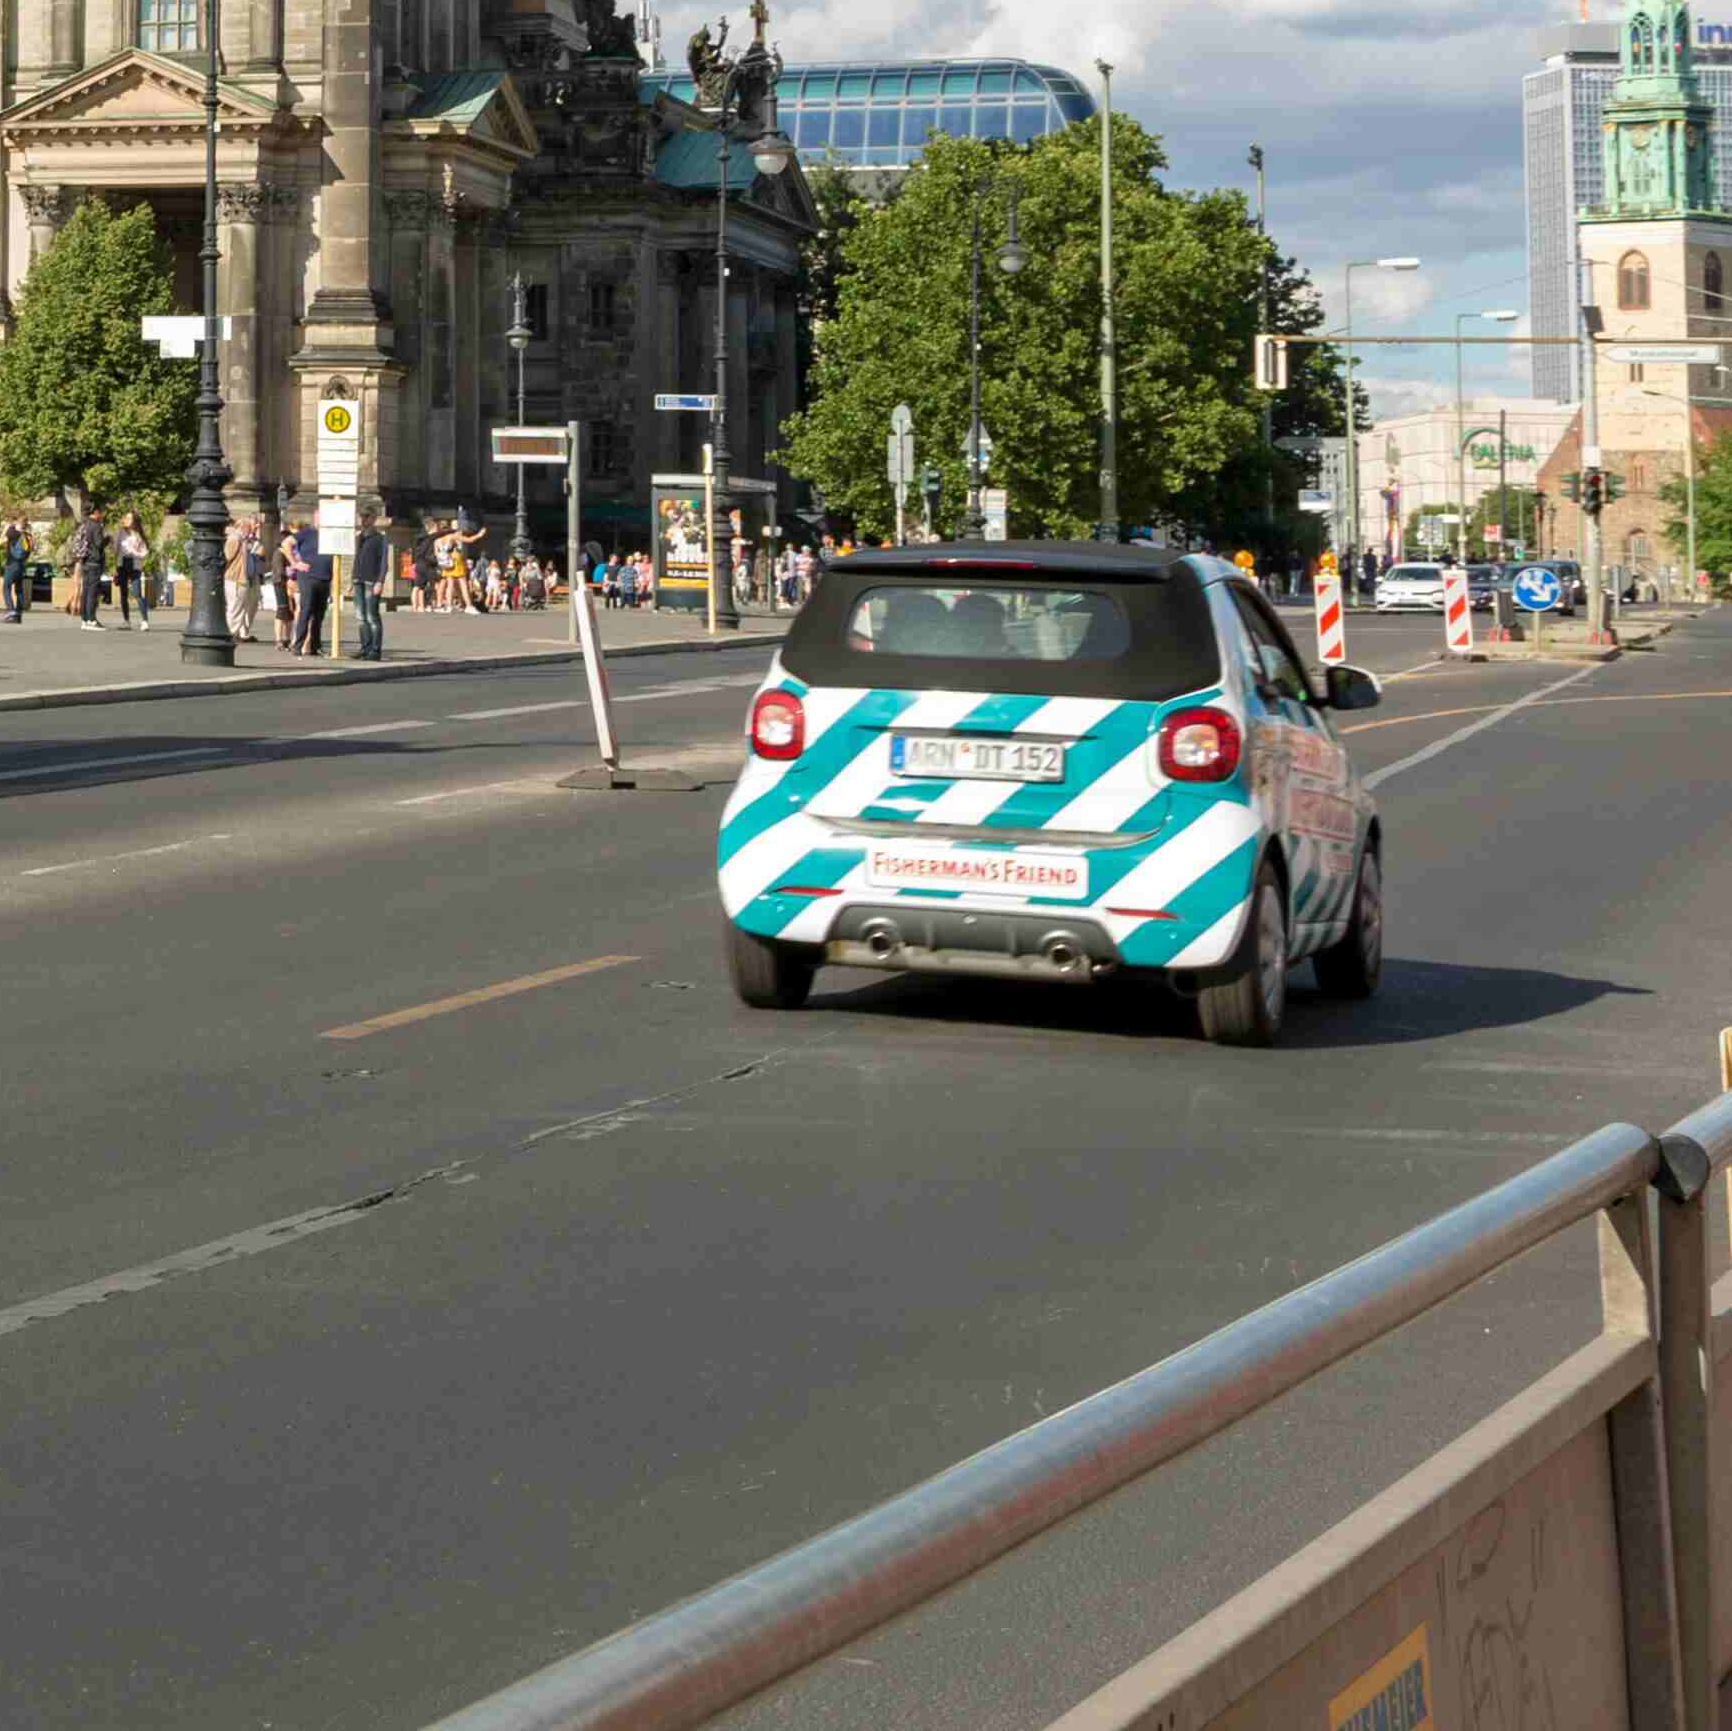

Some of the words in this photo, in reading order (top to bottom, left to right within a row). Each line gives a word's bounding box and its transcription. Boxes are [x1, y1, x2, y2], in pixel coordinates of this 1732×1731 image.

[976, 743, 1005, 770] DT
[1011, 745, 1059, 773] 152
[1003, 859, 1078, 885] FRIEND
